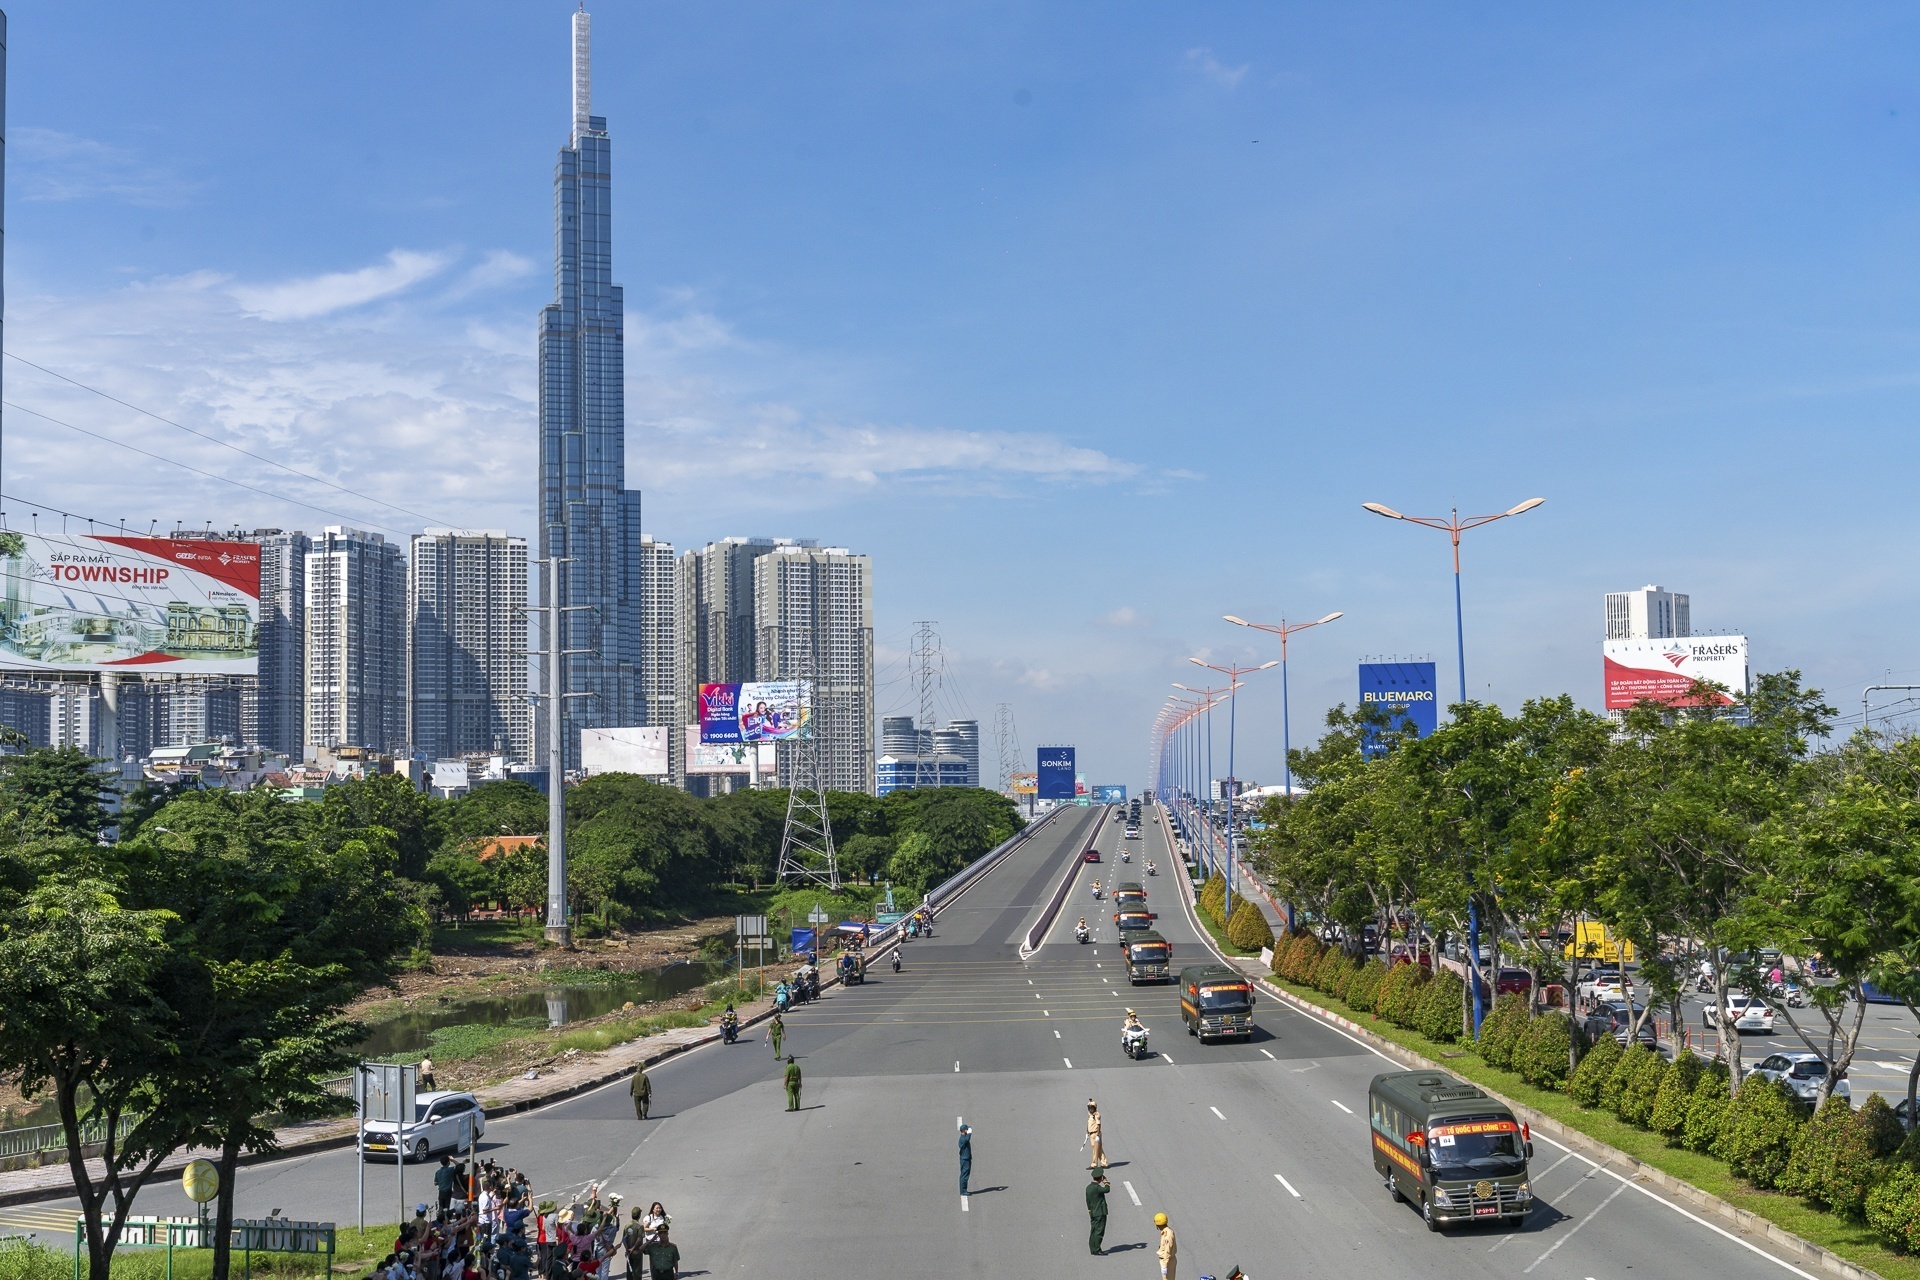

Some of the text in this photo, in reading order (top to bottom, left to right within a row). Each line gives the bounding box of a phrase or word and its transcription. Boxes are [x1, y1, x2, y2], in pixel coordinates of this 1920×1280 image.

[51, 565, 169, 584] TOWNSHIP
[1693, 645, 1738, 655] FRASERS
[702, 687, 734, 706] Vikki
[1364, 691, 1433, 702] BLUEMARQ
[1447, 1126, 1454, 1134] TỔ
[1455, 1125, 1471, 1134] QUỐC
